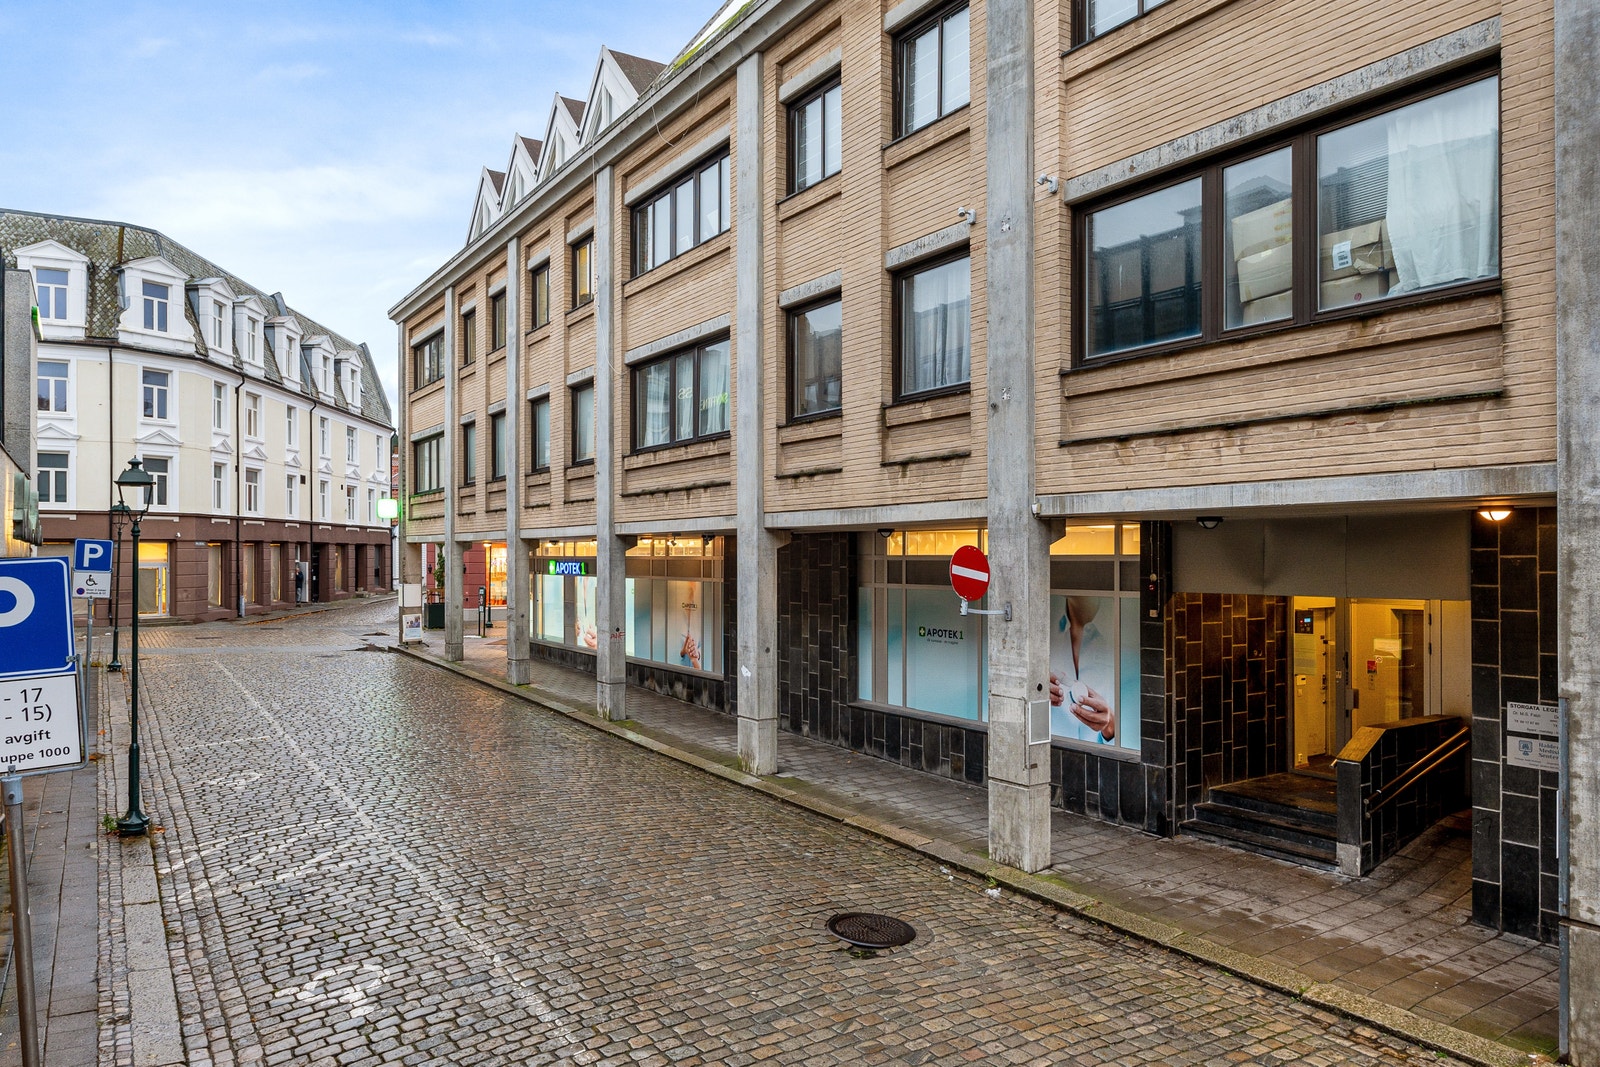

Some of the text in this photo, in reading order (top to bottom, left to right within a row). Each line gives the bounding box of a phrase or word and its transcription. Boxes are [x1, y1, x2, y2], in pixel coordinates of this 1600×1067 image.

[83, 544, 104, 568] P
[20, 688, 42, 704] 17
[22, 704, 52, 722] 15)
[5, 729, 52, 744] avgift
[0, 746, 70, 764] uppe 1000
